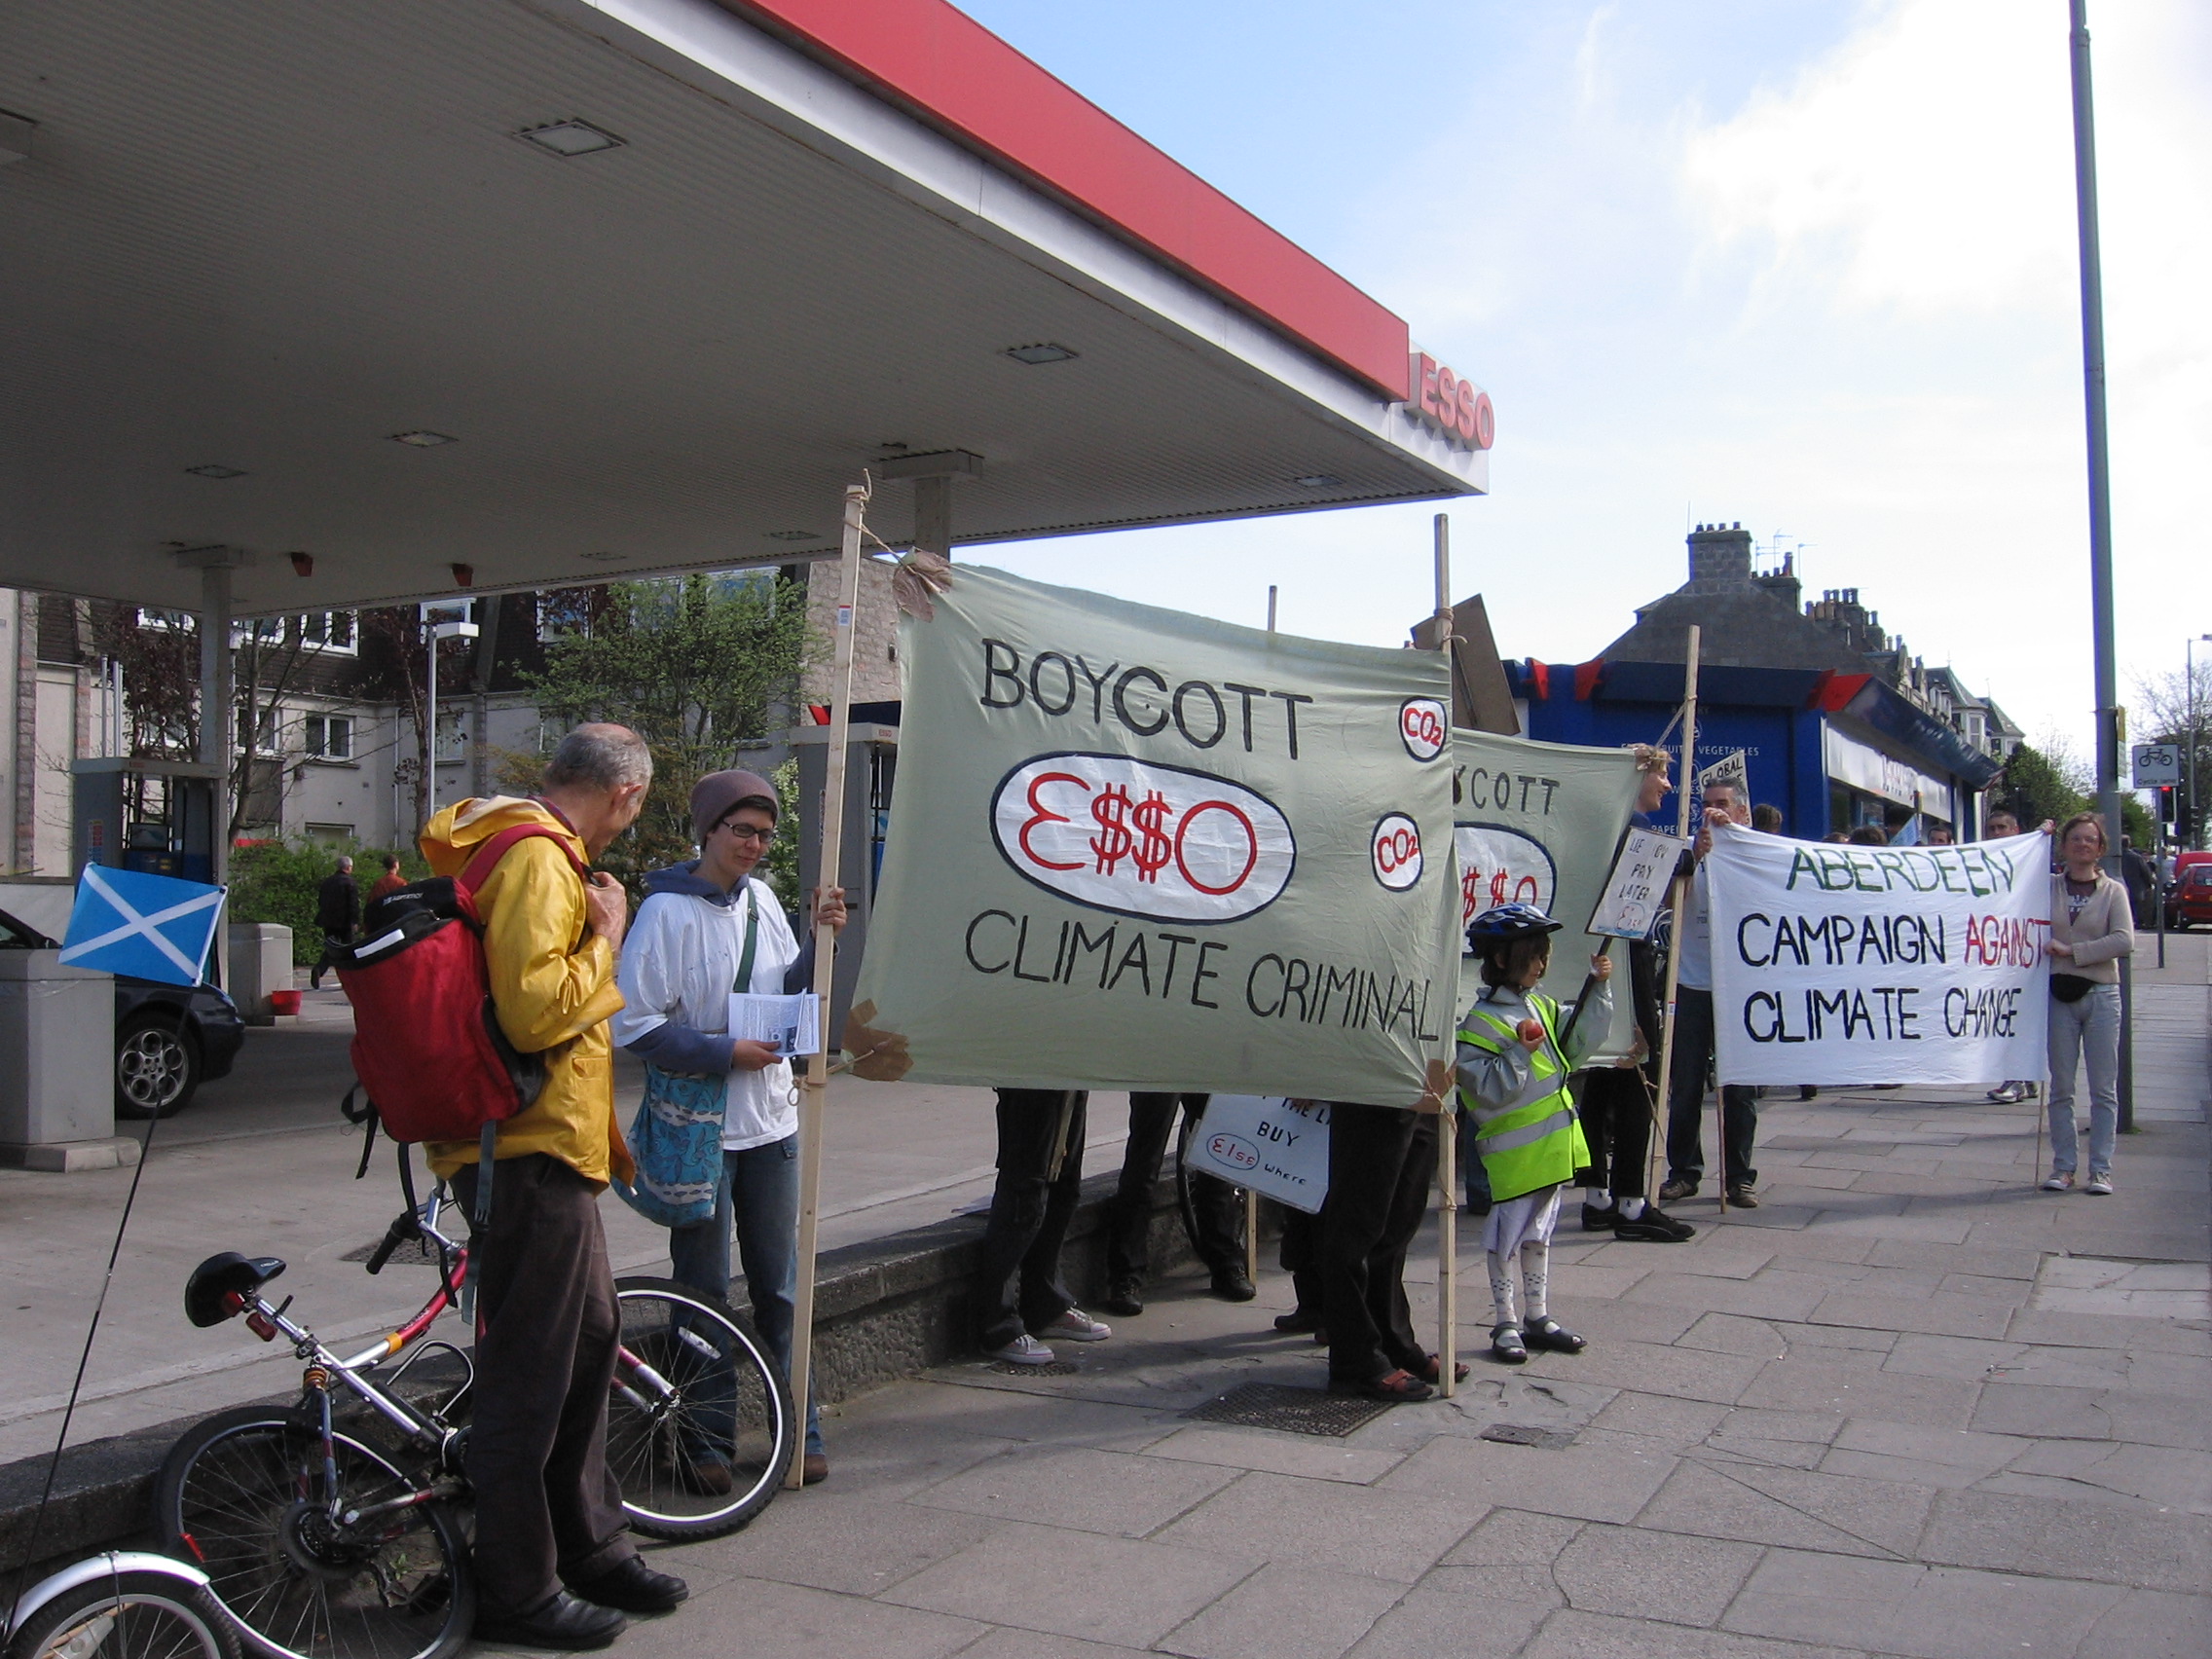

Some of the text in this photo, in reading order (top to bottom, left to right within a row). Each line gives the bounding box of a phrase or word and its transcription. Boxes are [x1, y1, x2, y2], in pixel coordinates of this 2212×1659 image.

[1419, 351, 1494, 450] ESSO
[980, 639, 1312, 760] BOYCOTT
[1786, 846, 2013, 897] ABERDEEN
[1738, 913, 1946, 967] CAMPAIGN
[1964, 913, 2051, 969] AGAINST
[965, 909, 1439, 1042] CLIMATE CRIMINAL
[1744, 987, 2021, 1042] CLIMATE CHANGE
[1257, 1121, 1300, 1147] BUY
